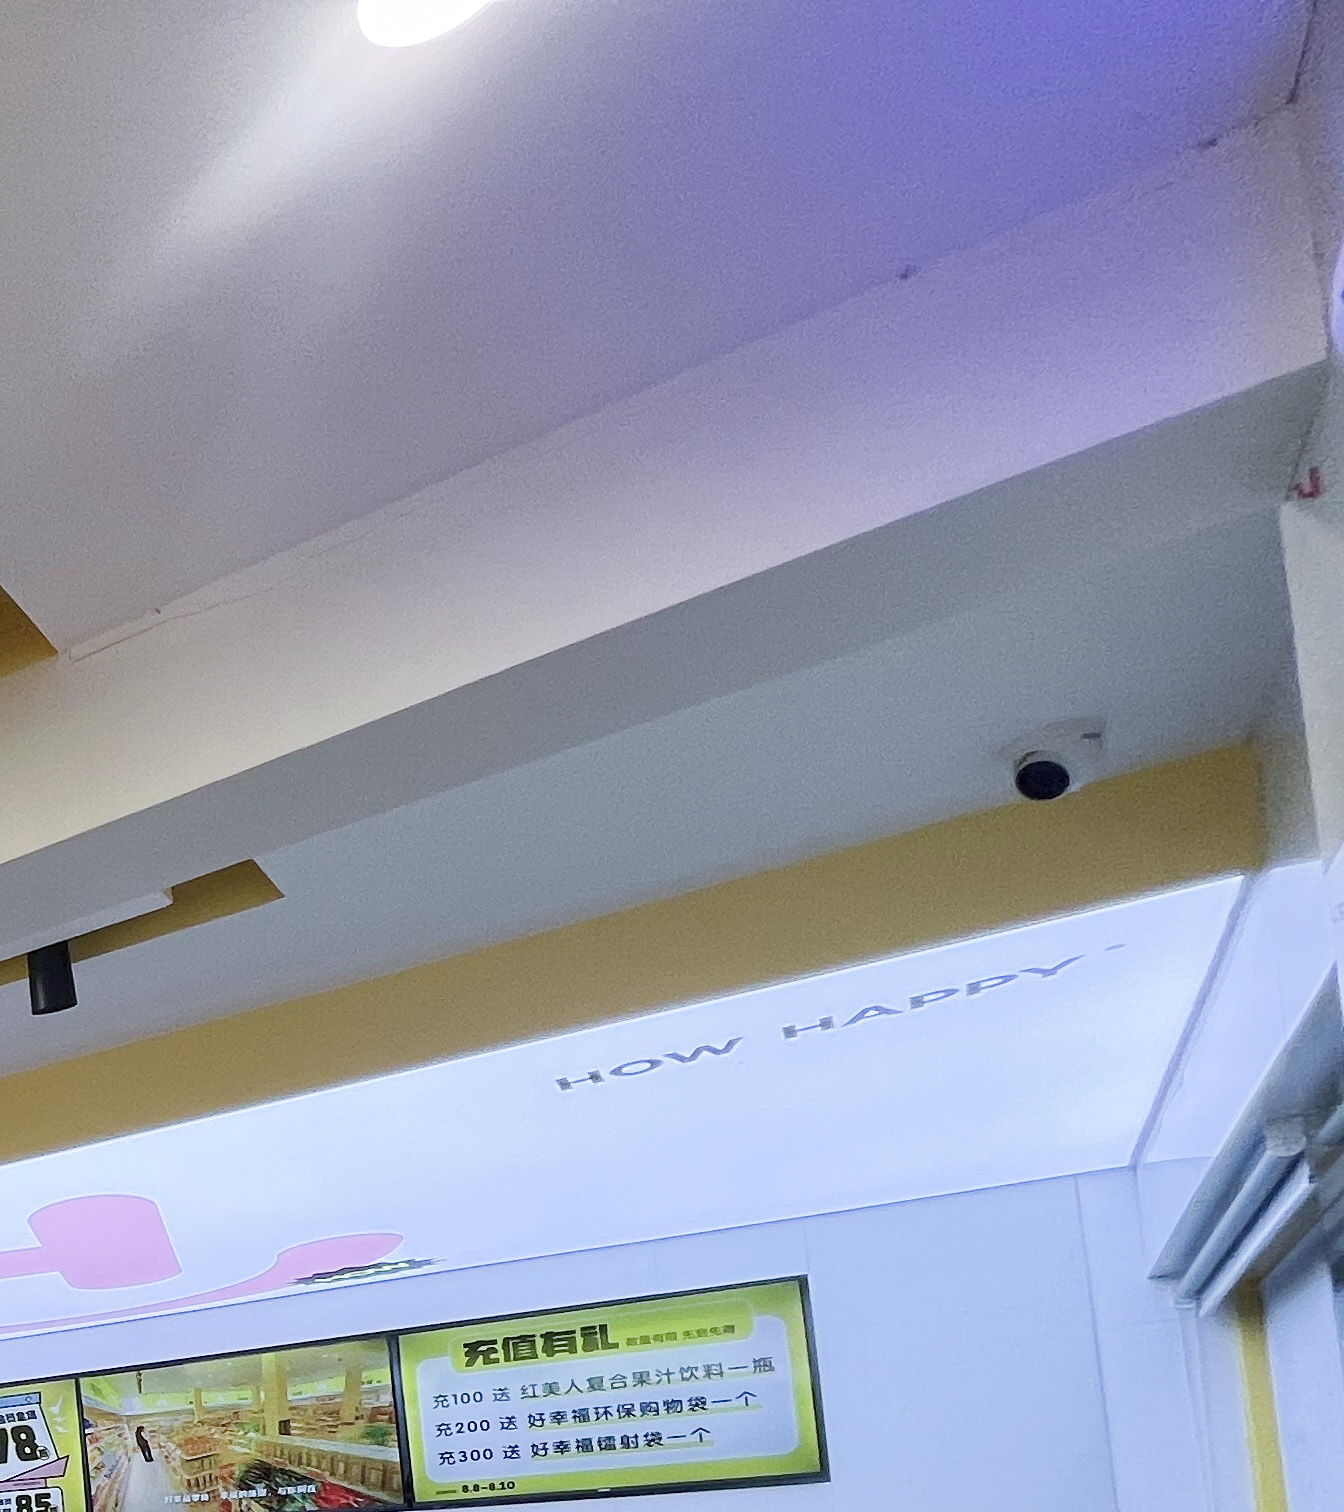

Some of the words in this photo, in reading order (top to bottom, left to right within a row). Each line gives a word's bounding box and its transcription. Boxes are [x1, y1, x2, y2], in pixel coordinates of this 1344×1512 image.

[557, 1036, 745, 1091] HOW
[782, 953, 1086, 1039] HAPPY
[432, 1391, 484, 1410] 充100
[492, 1388, 511, 1404] 送
[520, 1357, 775, 1399] 红美人复合果汁饮料一瓶
[435, 1418, 491, 1438] 充200
[499, 1416, 518, 1431] 送
[527, 1391, 757, 1430] 好幸福环保购物袋一个
[438, 1447, 494, 1467] 充300
[502, 1445, 521, 1460] 送
[531, 1426, 712, 1459] 好幸福镭射袋一个
